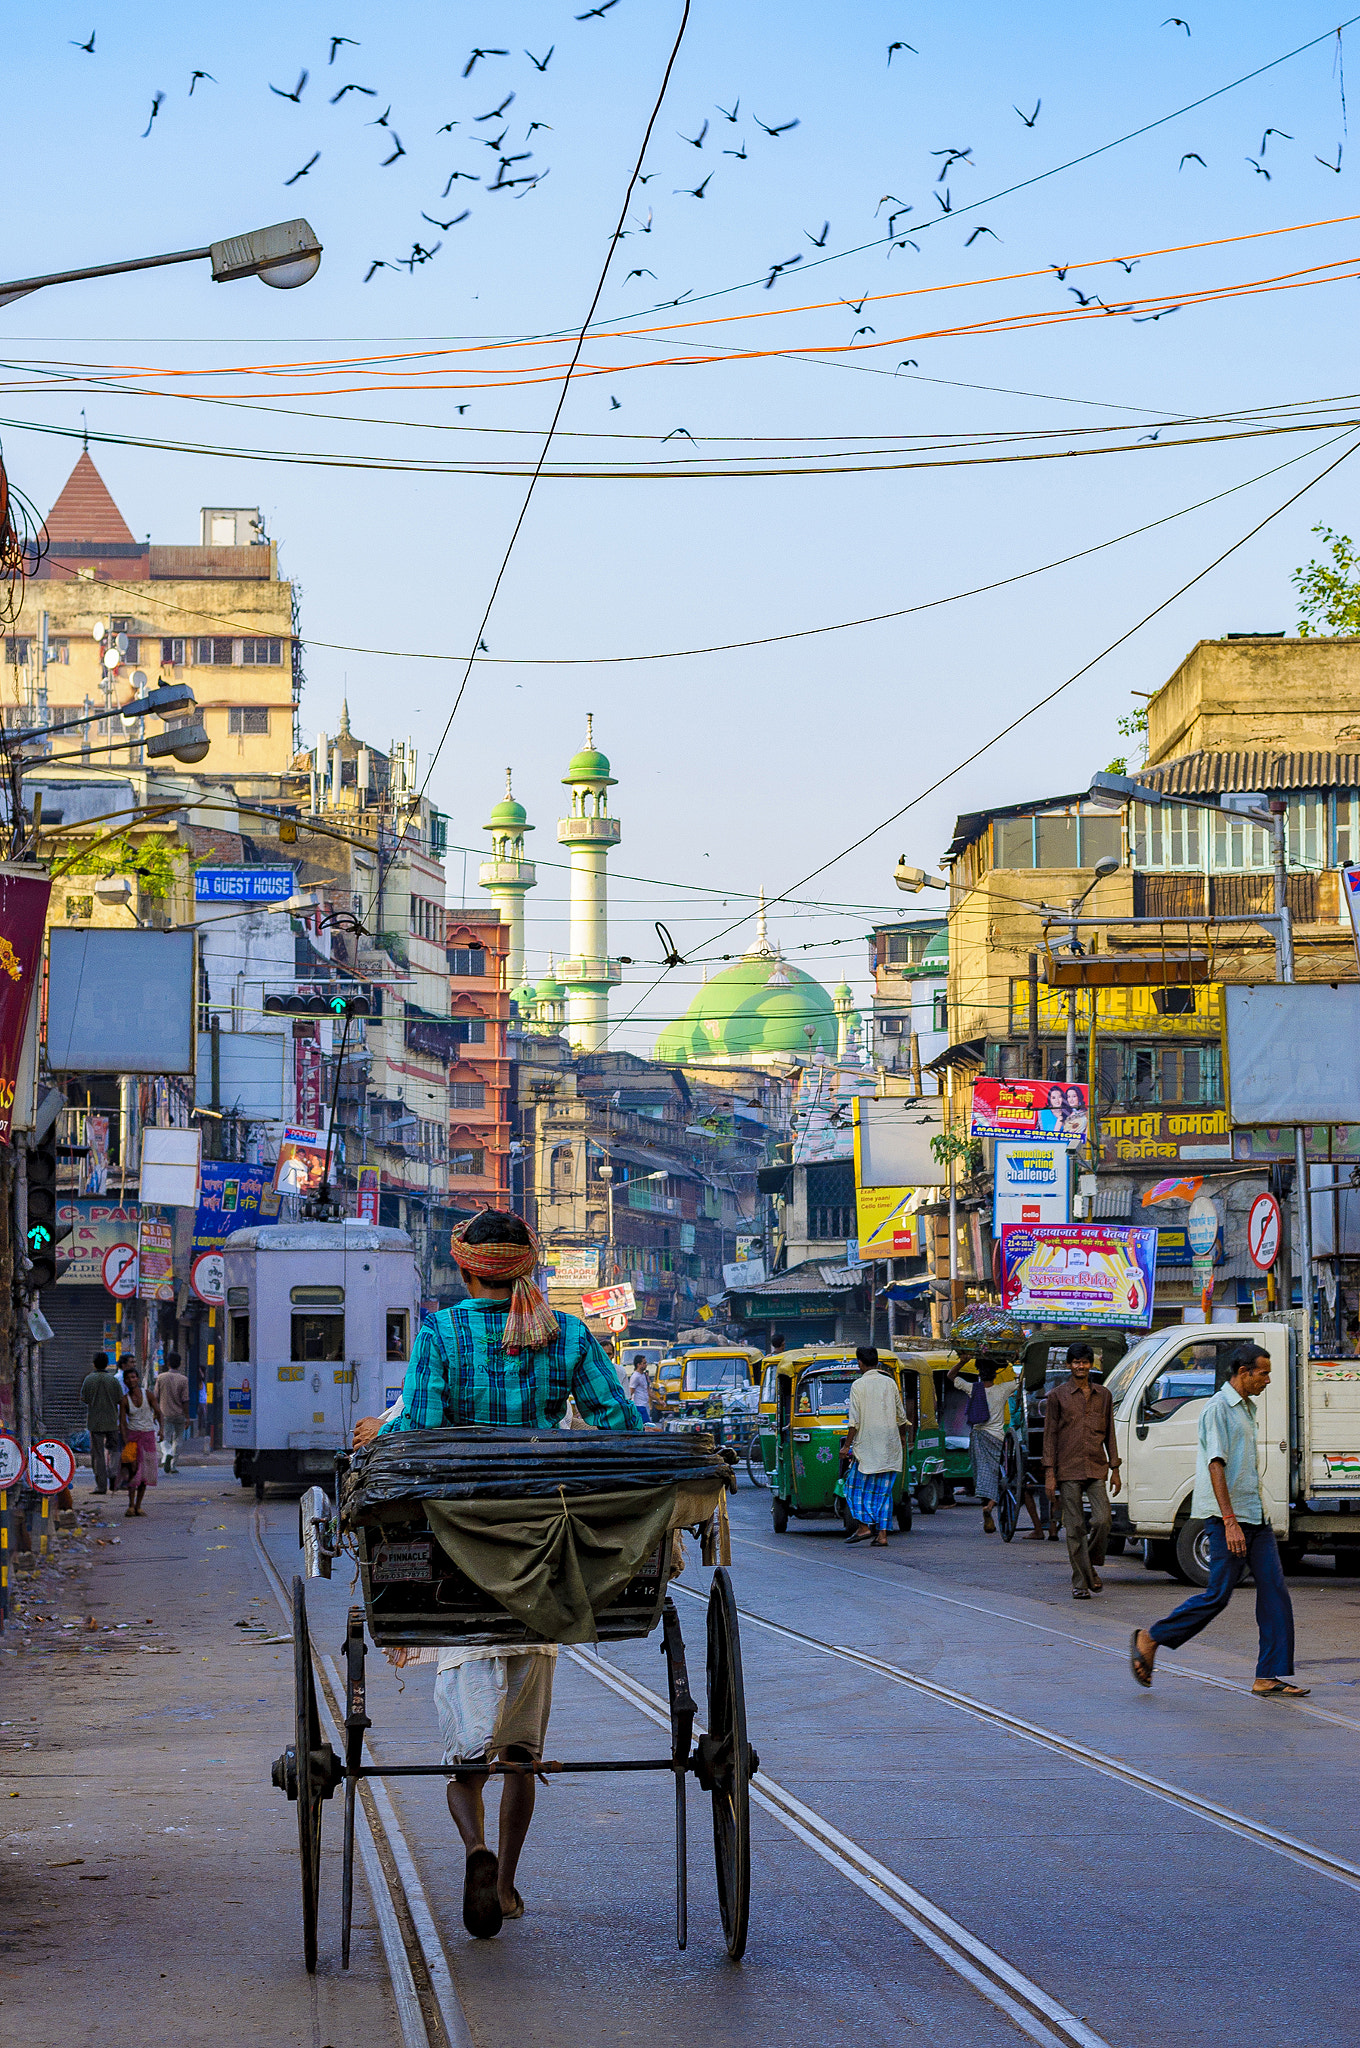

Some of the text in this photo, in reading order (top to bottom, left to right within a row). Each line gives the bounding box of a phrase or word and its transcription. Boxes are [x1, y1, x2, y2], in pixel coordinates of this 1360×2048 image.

[213, 877, 251, 895] GUEST
[253, 877, 290, 895] HOUSE
[976, 1126, 1082, 1139] MARUTI CREATION
[1012, 1149, 1055, 1159] smoothest
[1023, 1159, 1054, 1169] writing
[1005, 1168, 1058, 1181] challenge!
[141, 1235, 172, 1249] JEWELLERS
[278, 1367, 305, 1382] CTC
